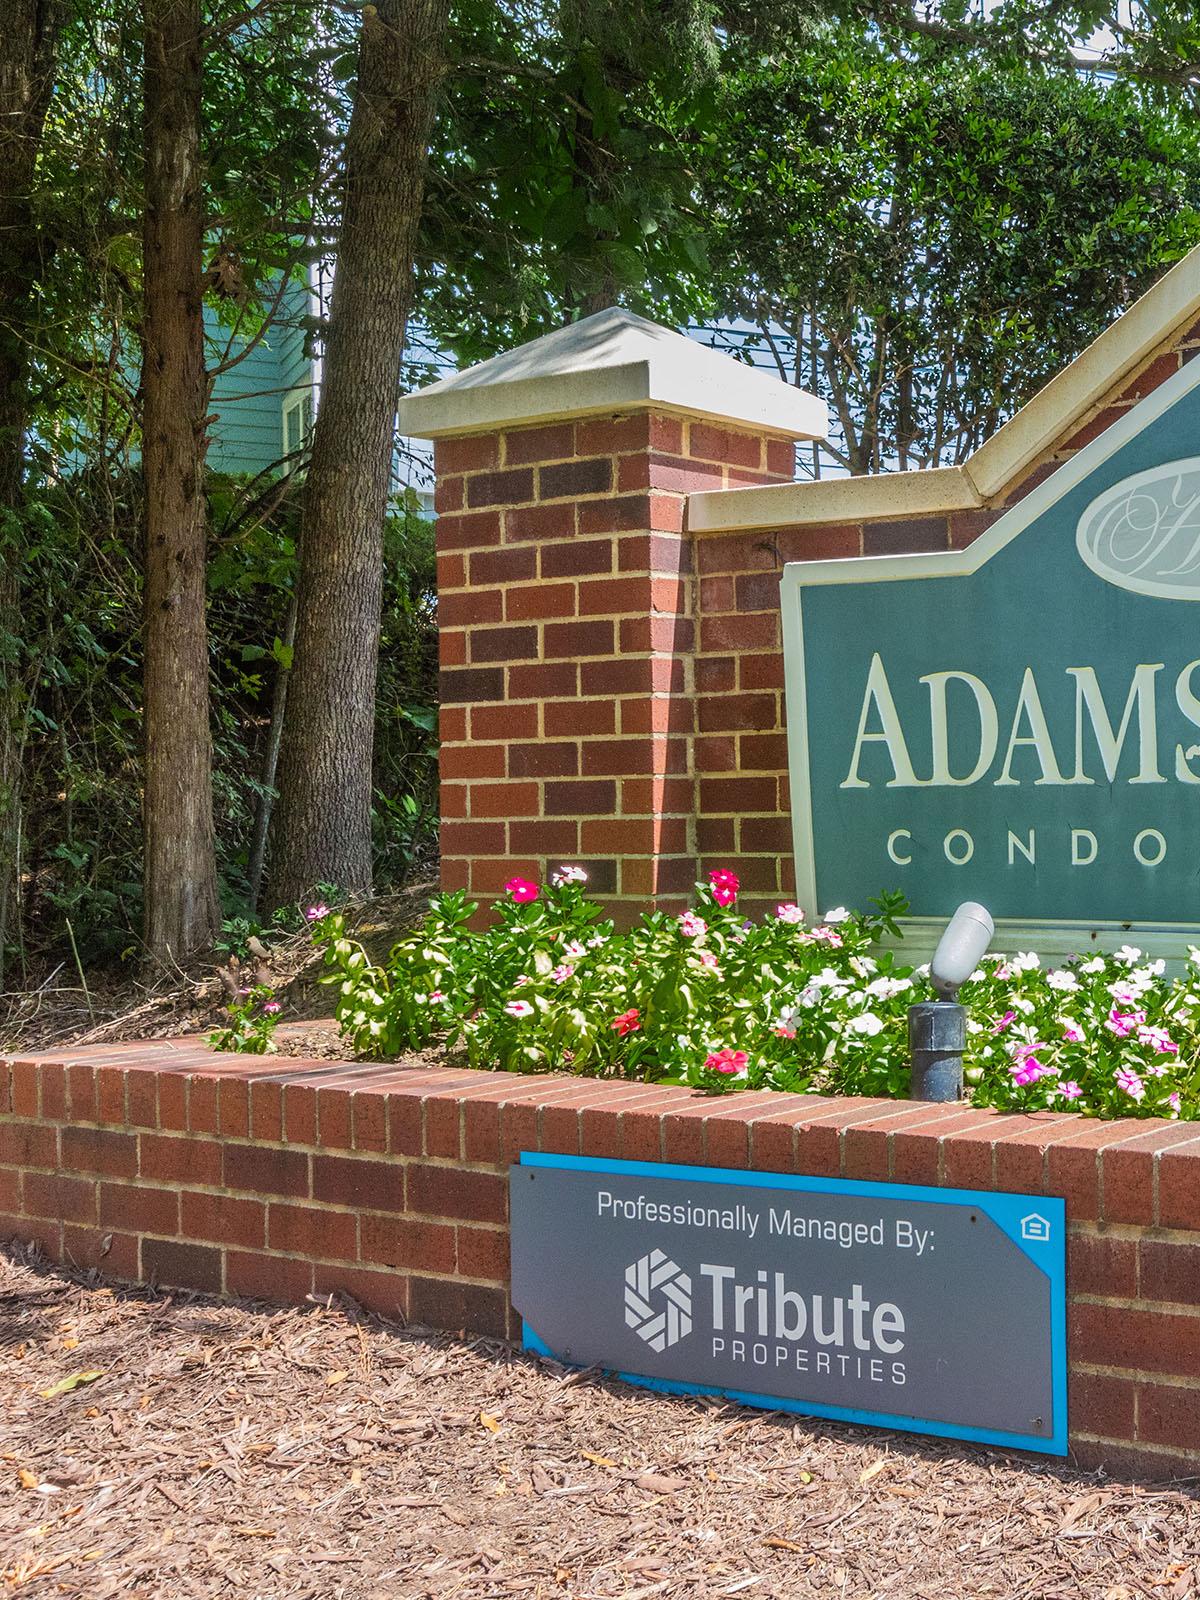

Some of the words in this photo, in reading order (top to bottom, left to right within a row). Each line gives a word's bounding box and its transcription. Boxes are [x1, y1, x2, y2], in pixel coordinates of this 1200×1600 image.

[597, 1191, 760, 1238] Professionally
[769, 1208, 884, 1248] Managed
[895, 1220, 936, 1256] By:
[700, 1263, 907, 1354] Tribute
[712, 1337, 907, 1385] PROPERTIES
